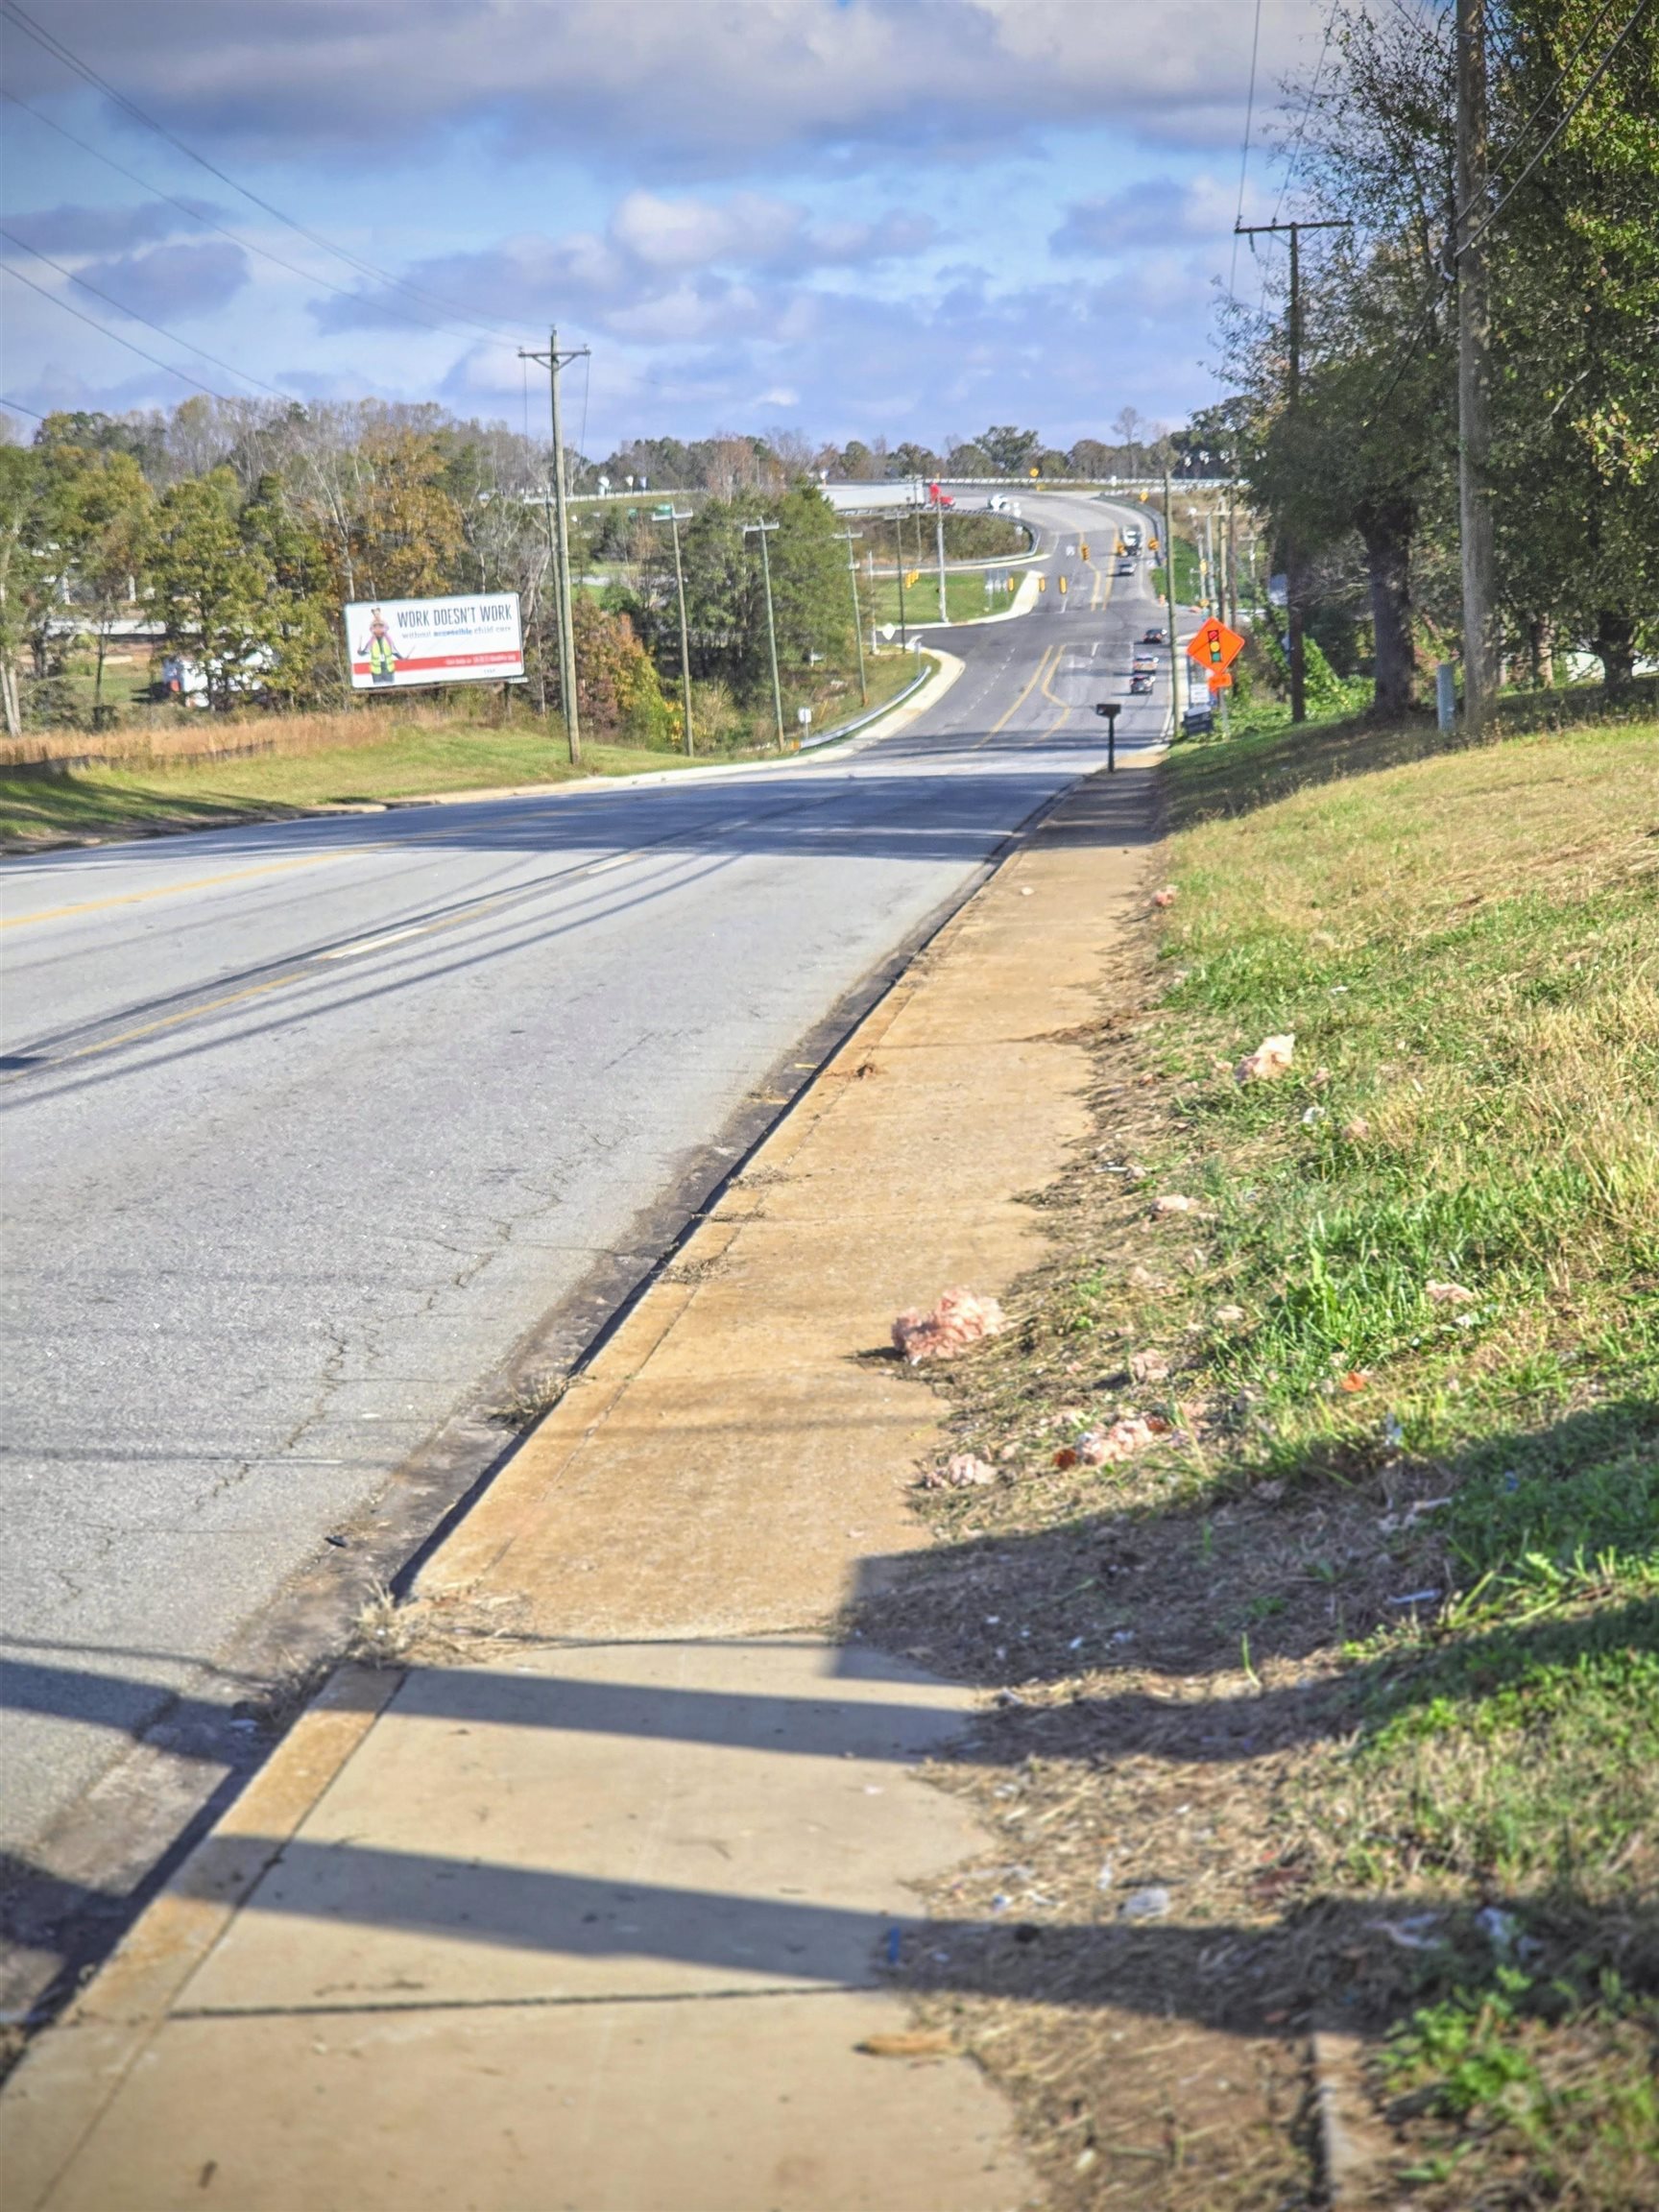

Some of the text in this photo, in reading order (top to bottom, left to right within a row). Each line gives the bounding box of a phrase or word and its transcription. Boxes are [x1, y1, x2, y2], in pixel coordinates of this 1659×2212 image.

[397, 604, 512, 628] WORK DOESN'T WORK
